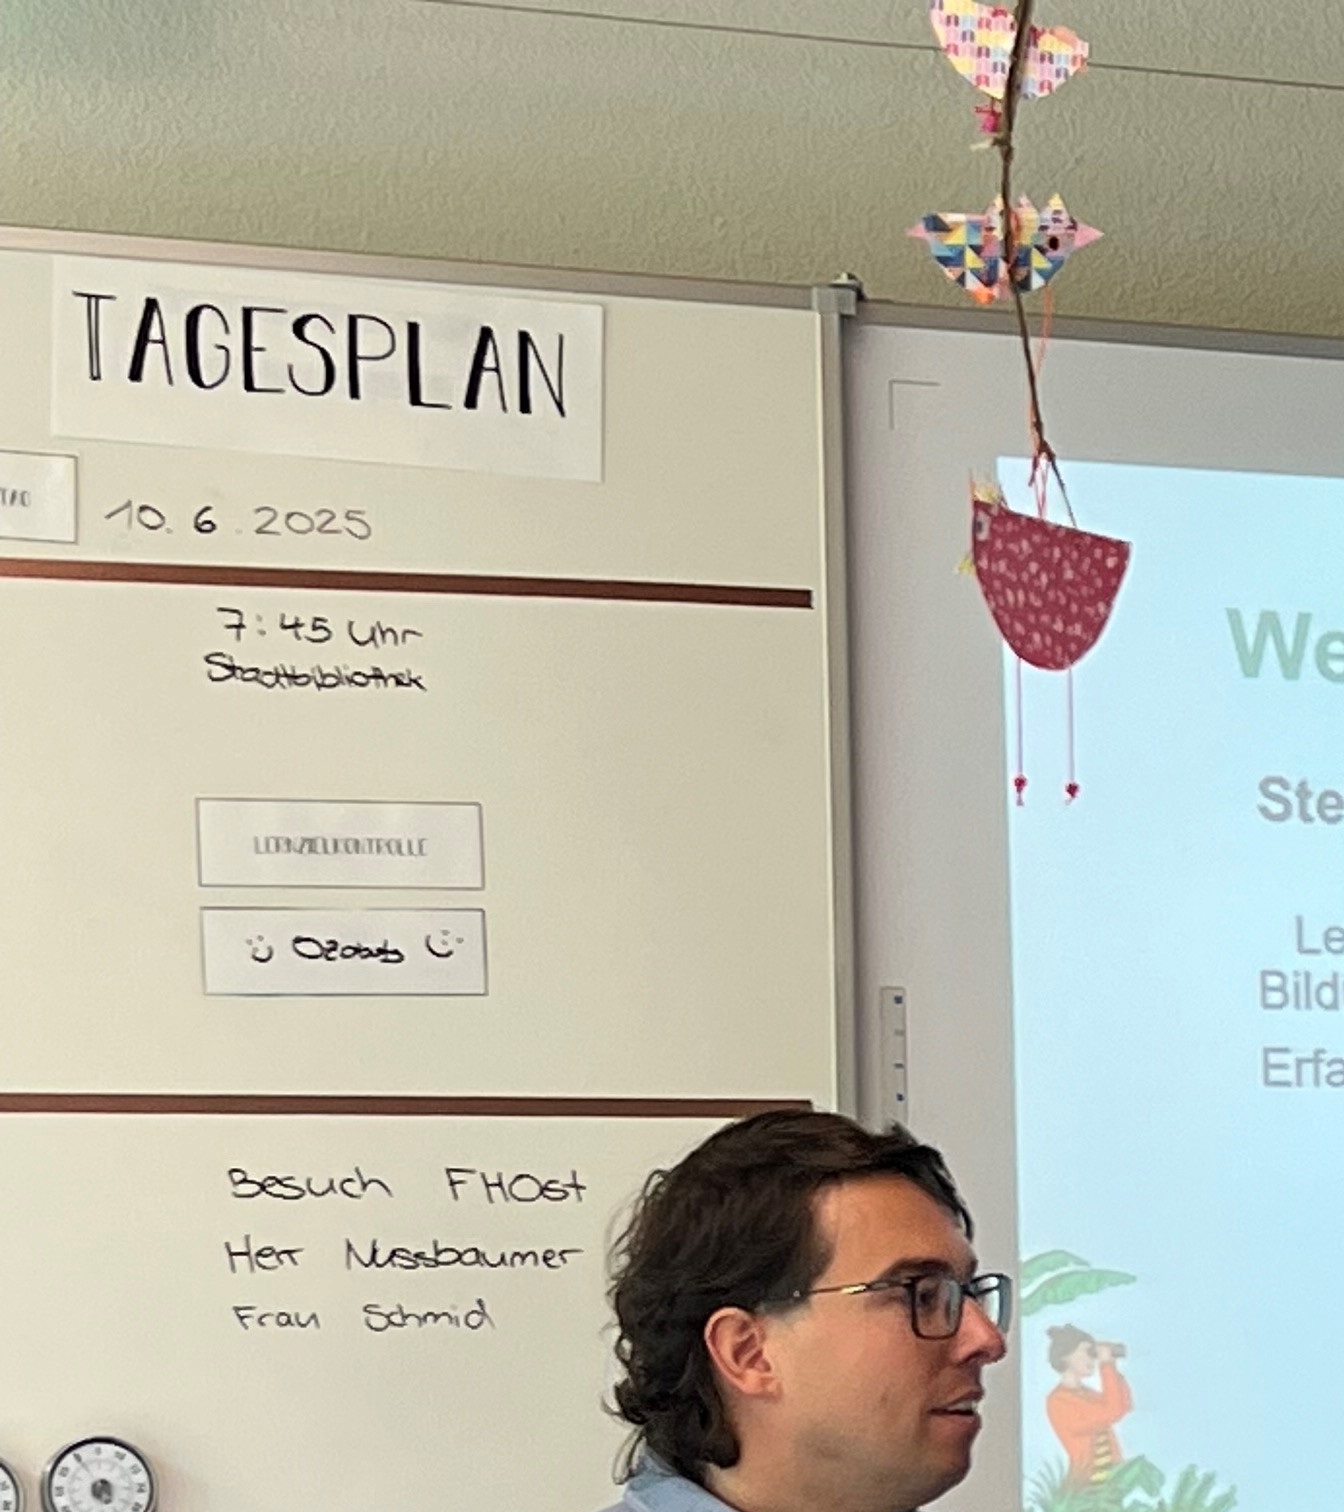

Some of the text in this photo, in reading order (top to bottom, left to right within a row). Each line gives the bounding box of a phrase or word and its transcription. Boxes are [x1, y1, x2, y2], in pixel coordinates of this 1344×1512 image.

[72, 290, 566, 418] TAGESPLAN
[104, 499, 173, 534] 10.
[254, 505, 372, 541] 2025
[216, 606, 424, 649] 7:45 Uhr
[203, 651, 428, 692] Stadtbibliothek
[227, 1166, 394, 1200] Besuch
[225, 1233, 585, 1274] Herr Nussbaumer
[232, 1297, 497, 1333] Frau Schmid
